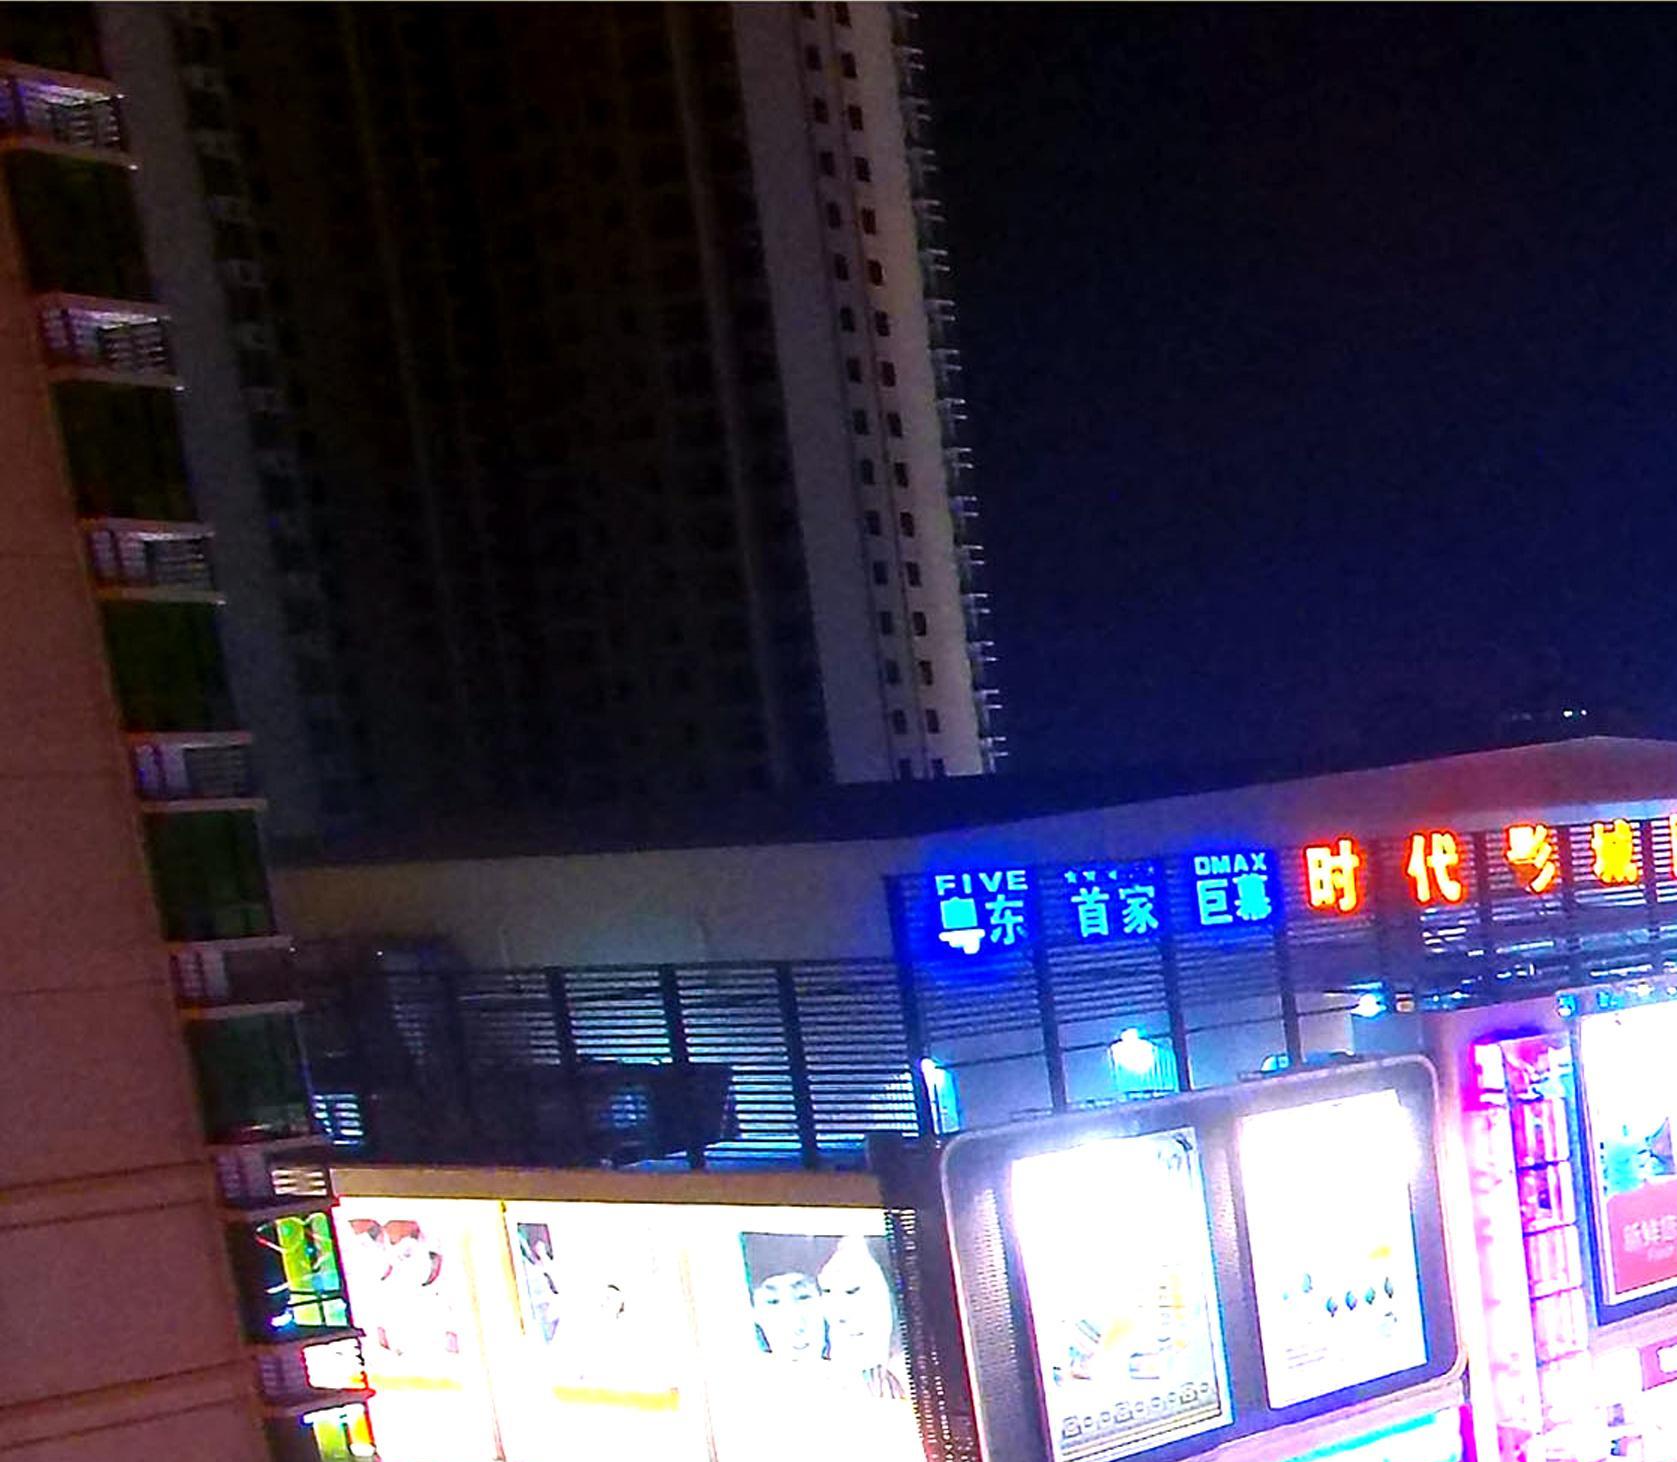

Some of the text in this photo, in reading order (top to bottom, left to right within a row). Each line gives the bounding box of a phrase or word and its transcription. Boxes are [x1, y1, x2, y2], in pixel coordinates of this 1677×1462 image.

[1193, 852, 1267, 877] DMAX
[934, 869, 1029, 896] FIVE
[1070, 884, 1159, 938] 首家
